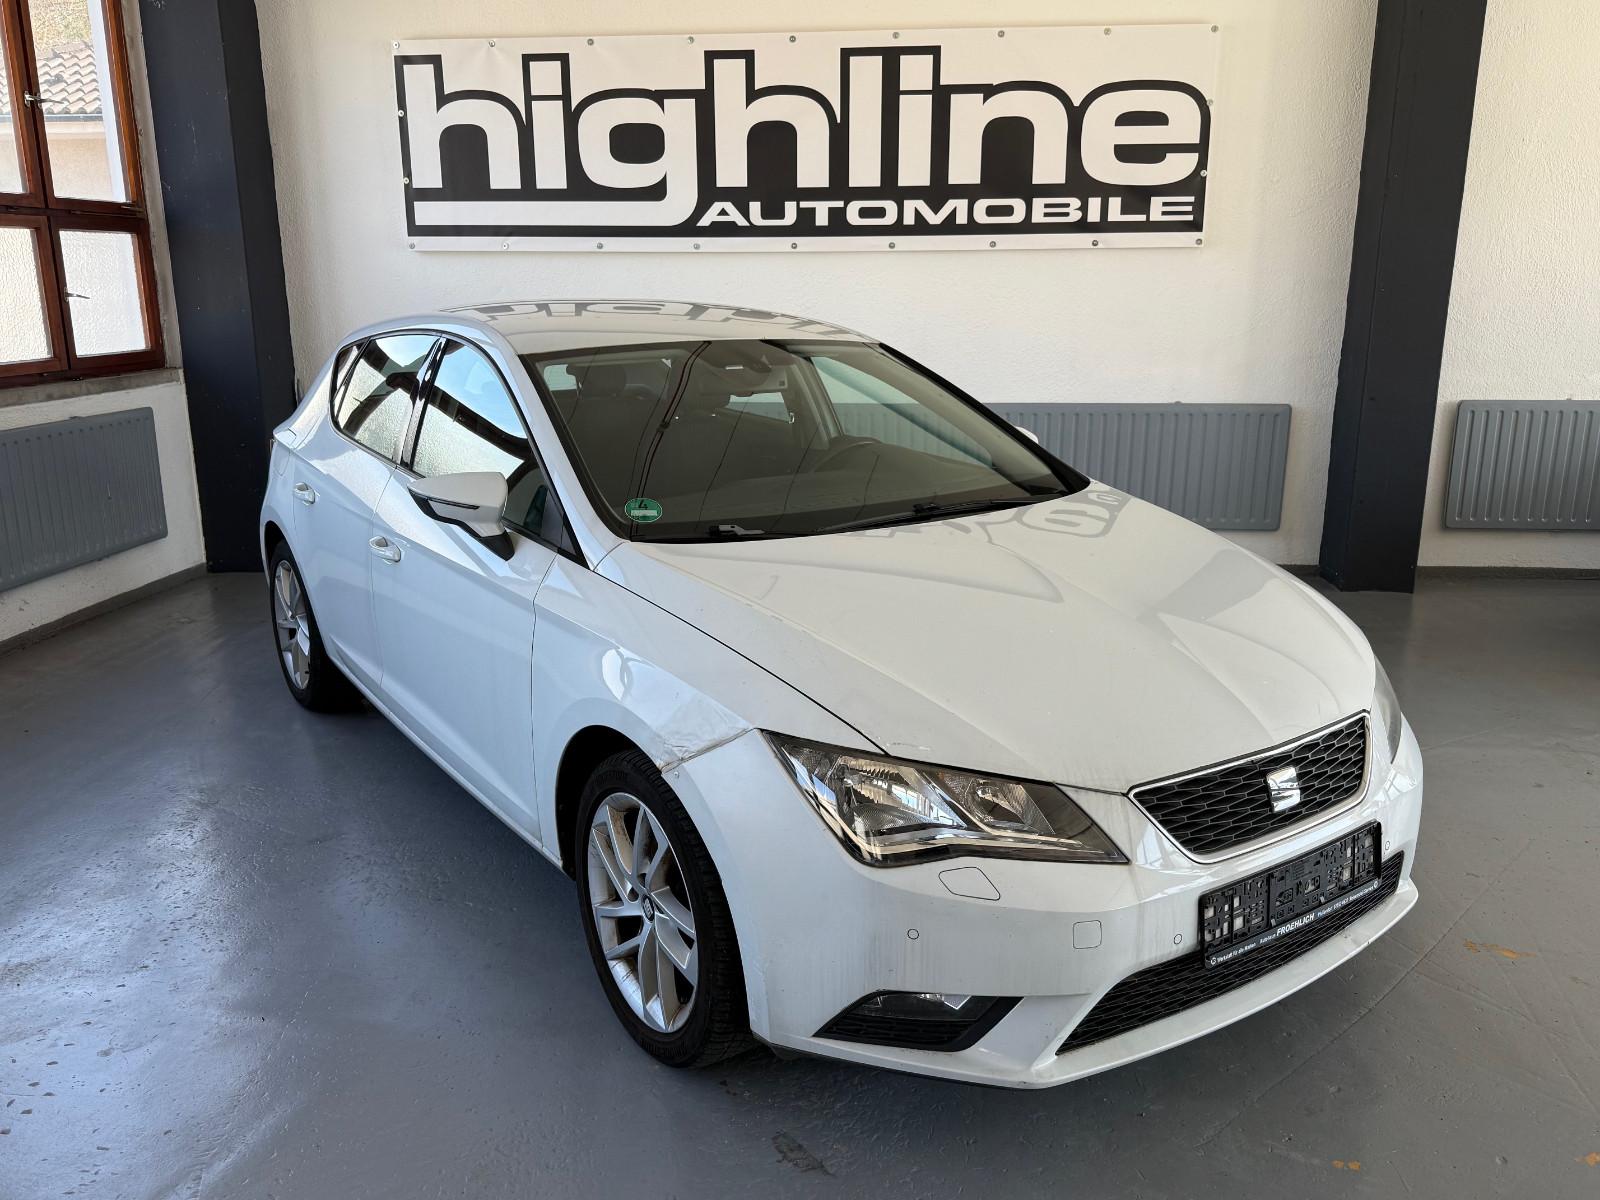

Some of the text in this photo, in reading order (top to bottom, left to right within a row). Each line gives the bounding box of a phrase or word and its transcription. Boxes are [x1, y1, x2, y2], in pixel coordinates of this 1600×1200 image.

[400, 50, 1204, 228] highline
[696, 194, 1196, 227] AUTOMOBILE
[638, 499, 648, 510] 4
[1276, 912, 1315, 937] FROEHLICH
